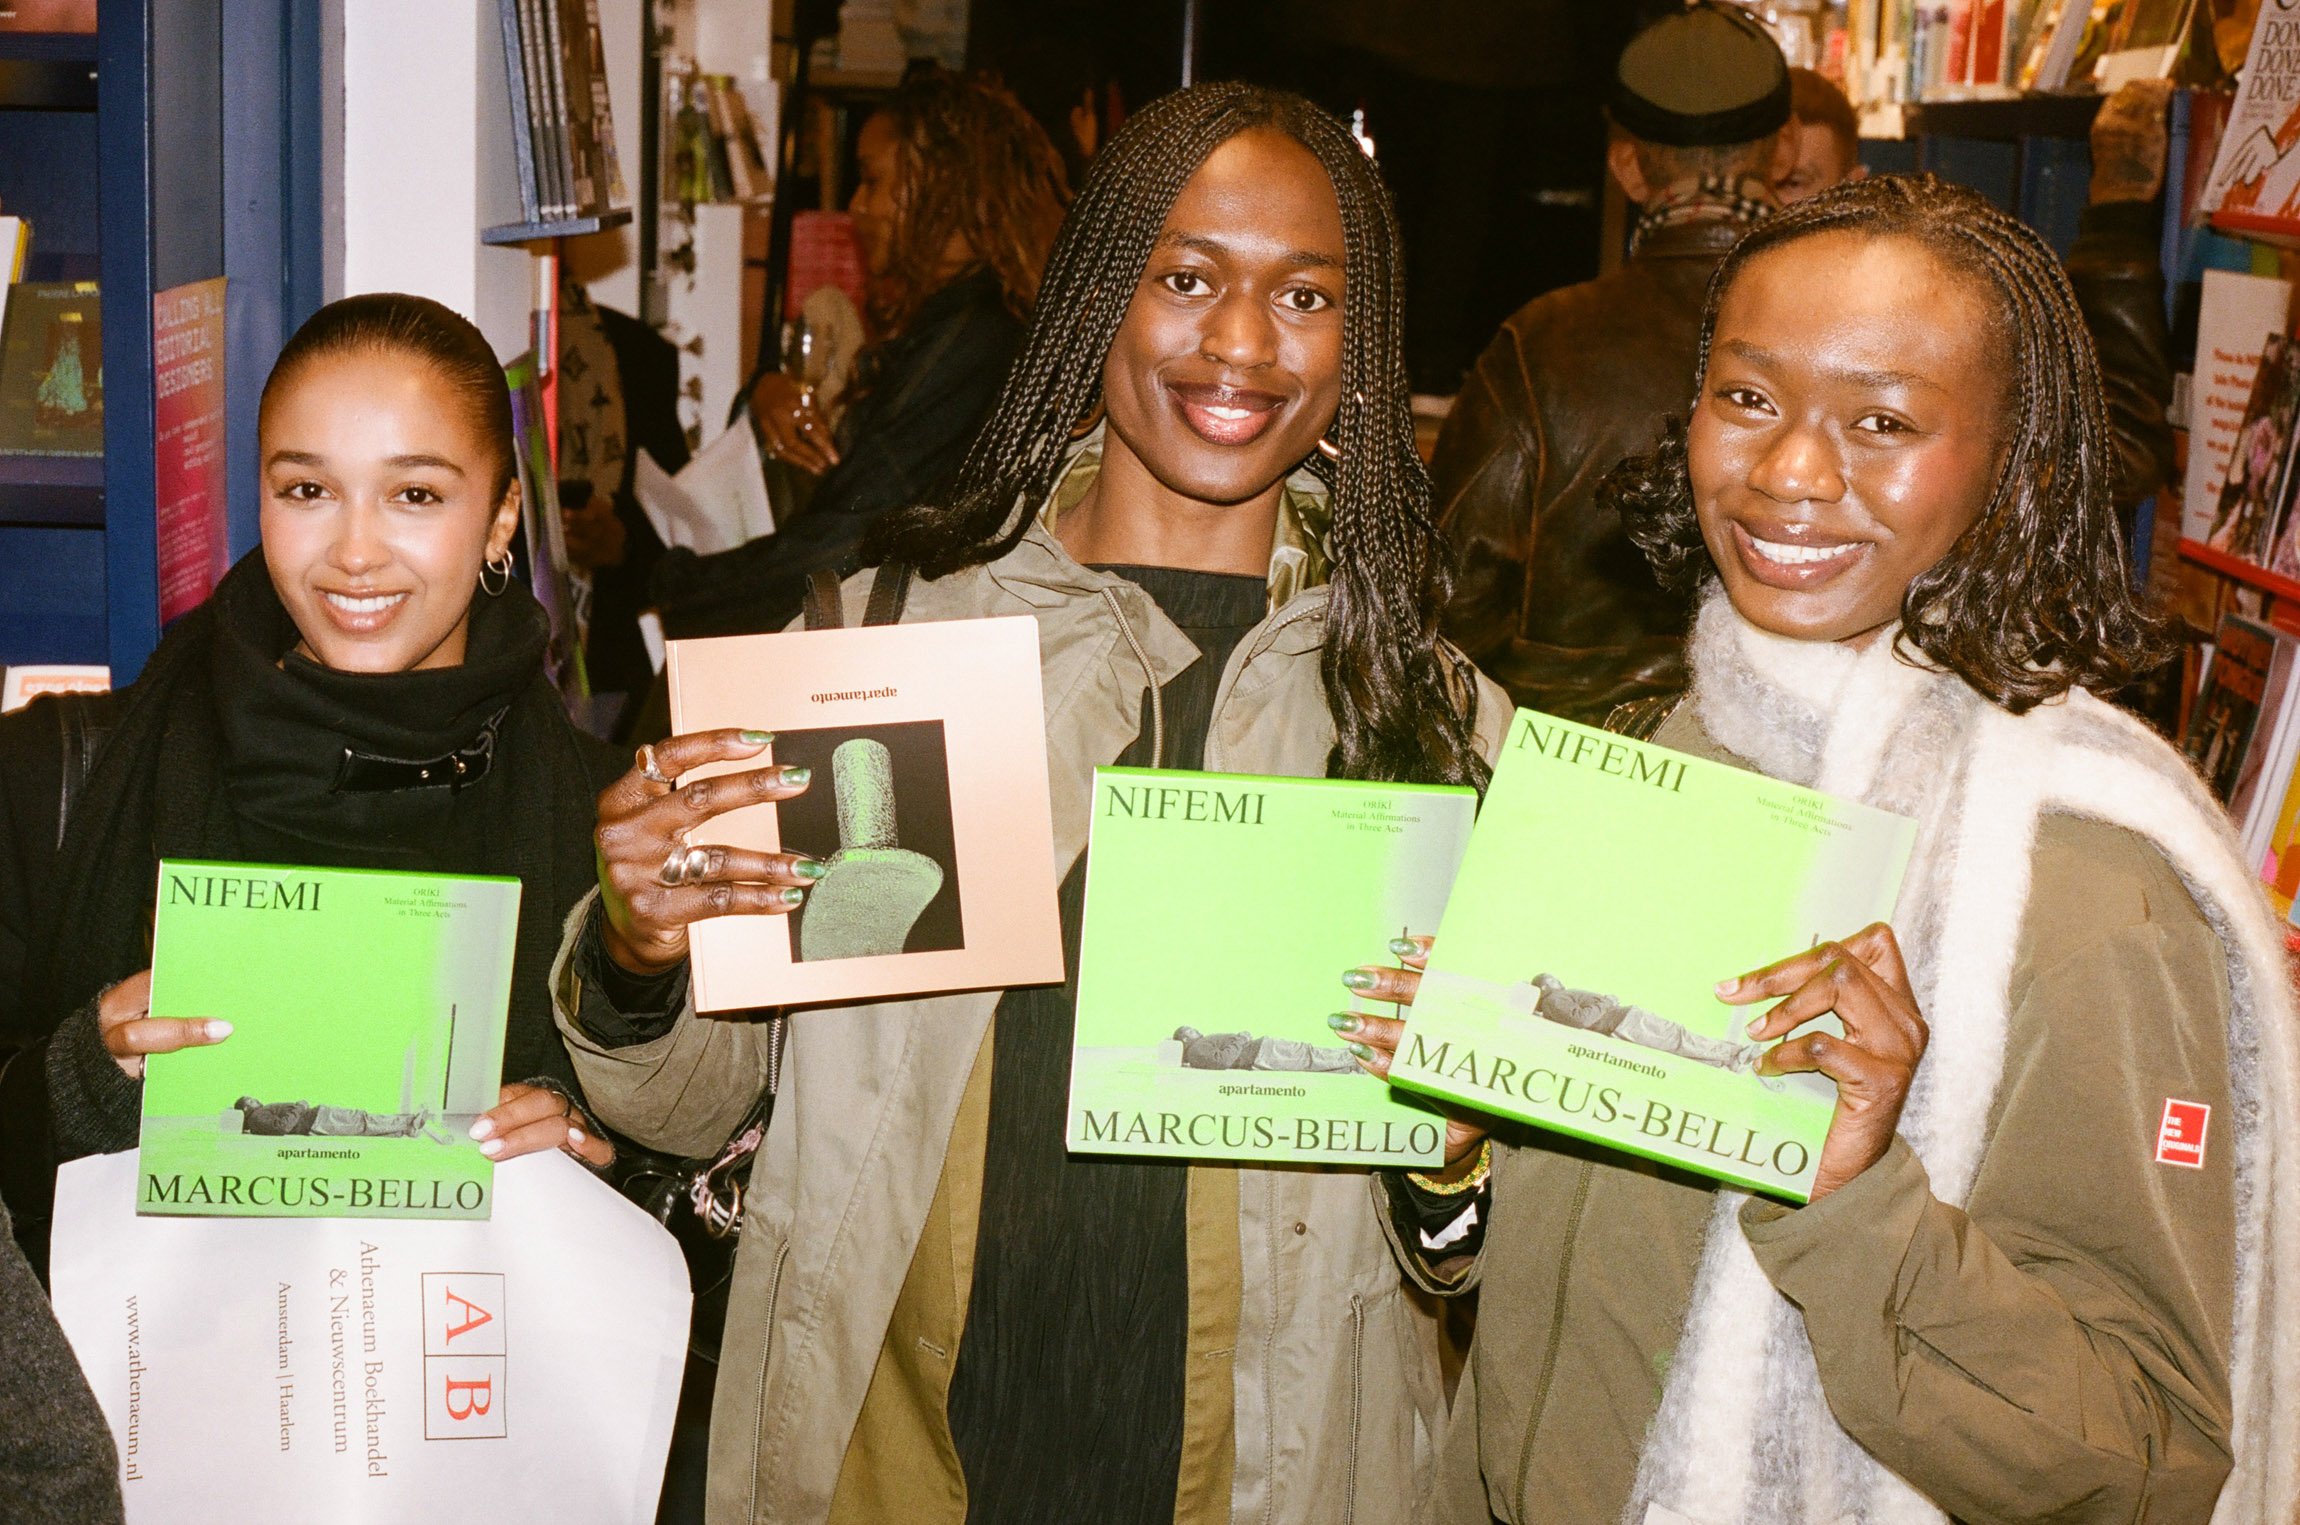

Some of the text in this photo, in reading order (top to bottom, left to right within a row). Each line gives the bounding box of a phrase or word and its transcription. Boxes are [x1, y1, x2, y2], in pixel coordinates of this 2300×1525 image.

[811, 686, 898, 704] apartamento
[1515, 719, 1690, 793] NIFEMI
[1106, 785, 1267, 825] NIFEMI
[1331, 810, 1421, 823] Material Affirmations
[1756, 796, 1852, 831] Material Affirmations
[1359, 823, 1382, 833] Three
[1385, 825, 1404, 833] Acts
[1784, 816, 1809, 829] Three
[1813, 824, 1832, 836] Acts
[170, 875, 323, 911] NIFEMI
[384, 898, 467, 909] Material Affirmations
[409, 909, 431, 918] Three
[433, 910, 451, 919] Acts
[1567, 1040, 1667, 1081] apartamento
[1218, 1083, 1307, 1098] apartamento
[1403, 1032, 1810, 1177] MARCUS-BELLO
[1080, 1109, 1440, 1155] MARCUS-BELLO
[2167, 1116, 2182, 1126] THE
[277, 1147, 361, 1161] apartamento
[146, 1173, 484, 1210] MARCUS-BELLO
[278, 1281, 292, 1370] Amsterdam
[329, 1268, 349, 1454] & Nieuwscentrum
[359, 1240, 388, 1478] Athenaeum Boekhandel
[445, 1286, 493, 1421] A B
[126, 1295, 148, 1482] www.athenaeum.nl
[279, 1383, 295, 1452] Haarlem
